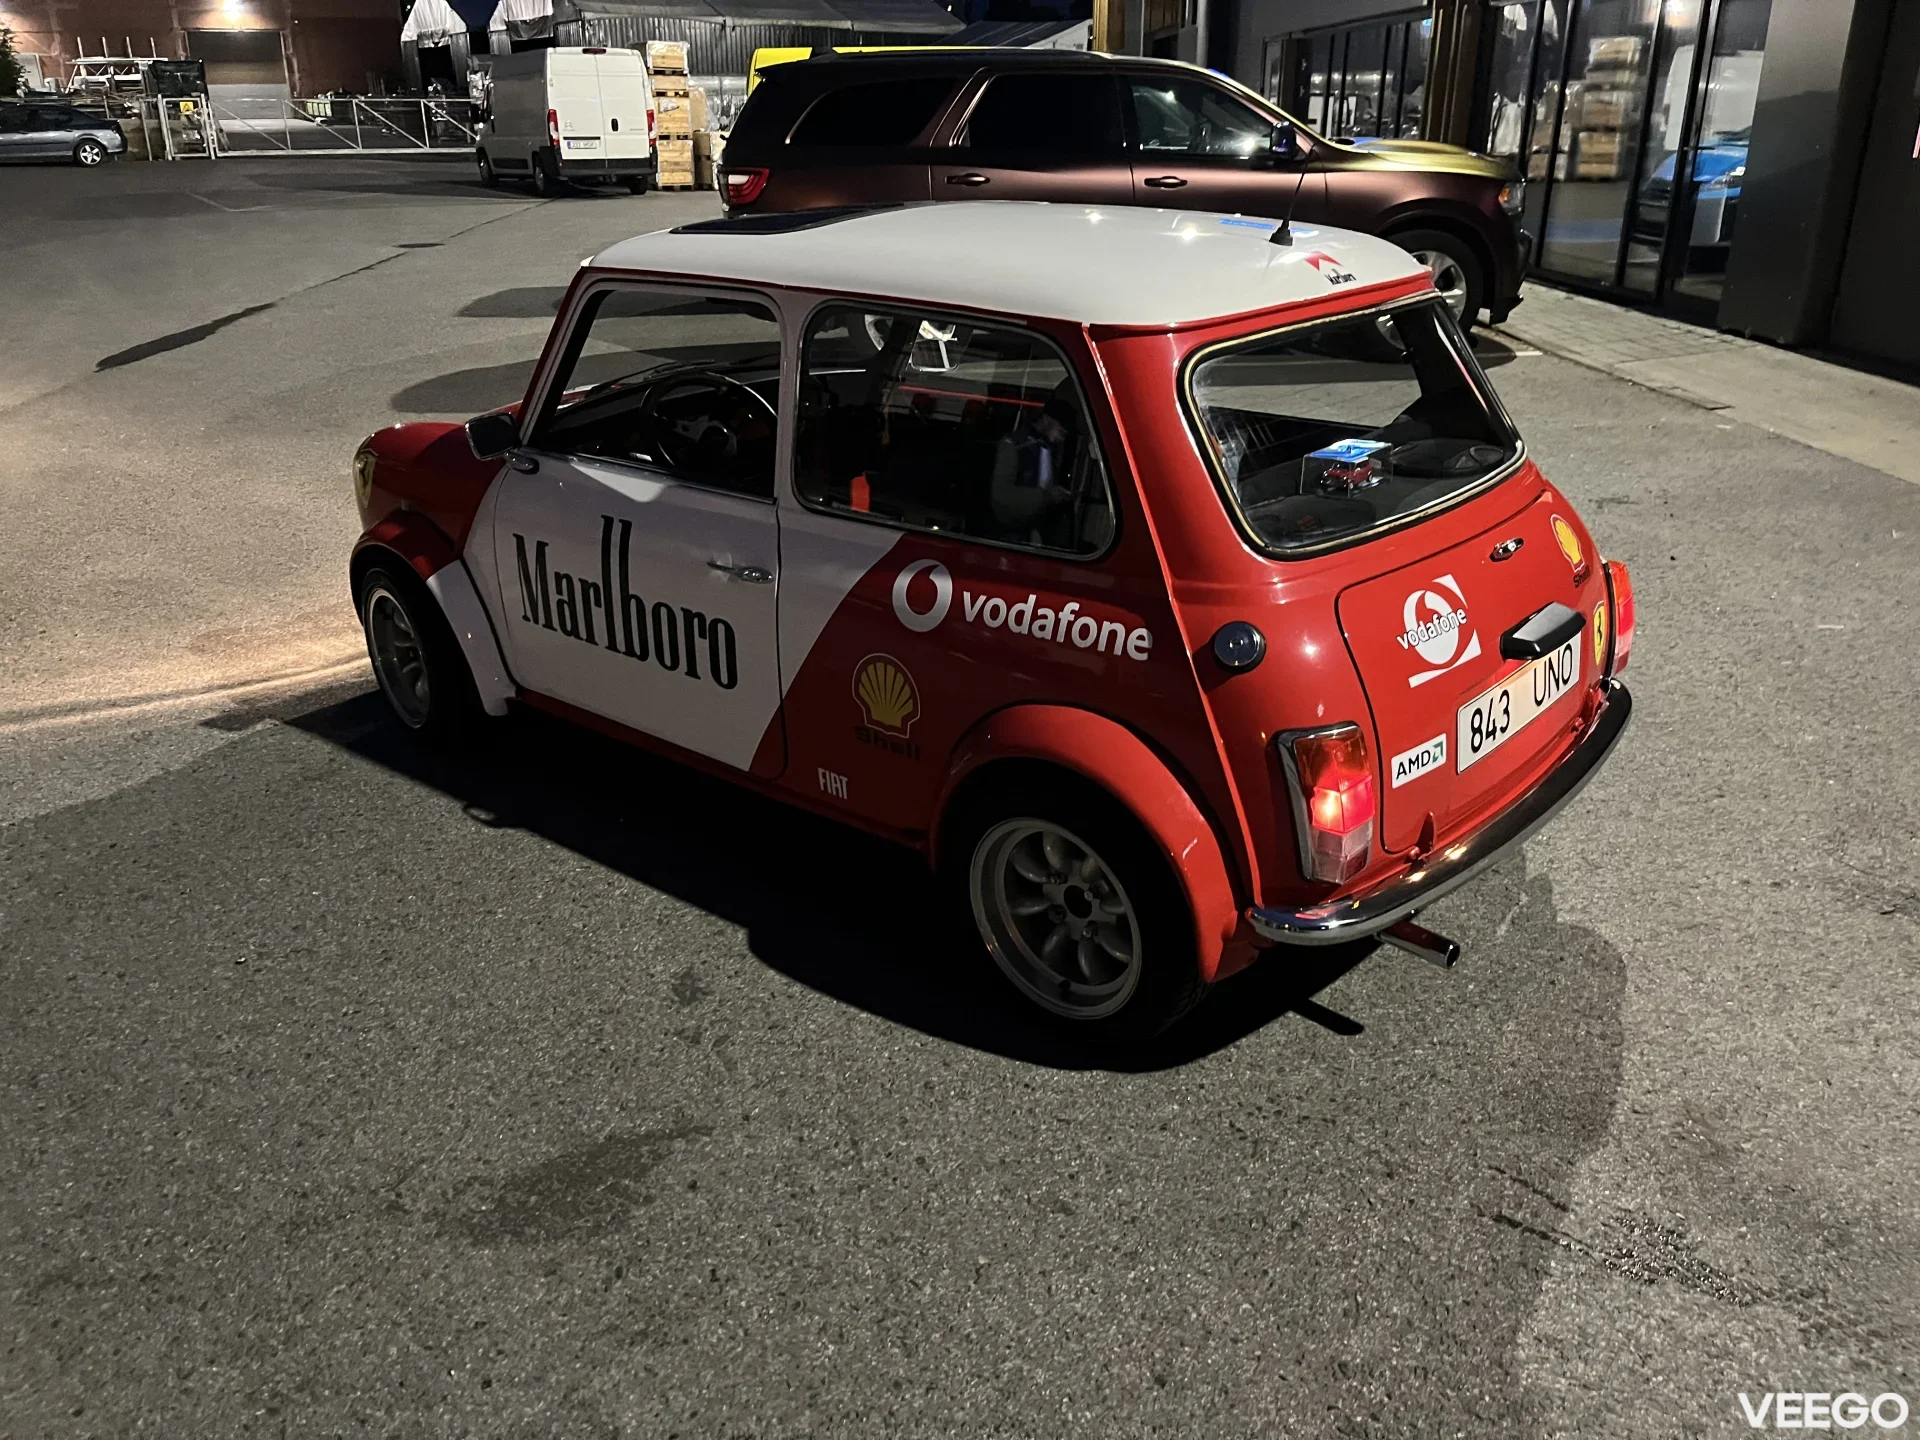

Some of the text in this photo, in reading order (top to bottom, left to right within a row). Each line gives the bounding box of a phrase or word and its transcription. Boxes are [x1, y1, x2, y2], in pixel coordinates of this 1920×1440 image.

[512, 514, 738, 690] Marlboro
[963, 591, 1153, 661] vodafone
[1396, 608, 1468, 650] vodafone
[1471, 643, 1573, 753] 843 UNO
[854, 727, 920, 761] Shell
[1396, 750, 1431, 780] AMD
[817, 767, 848, 800] FIAT
